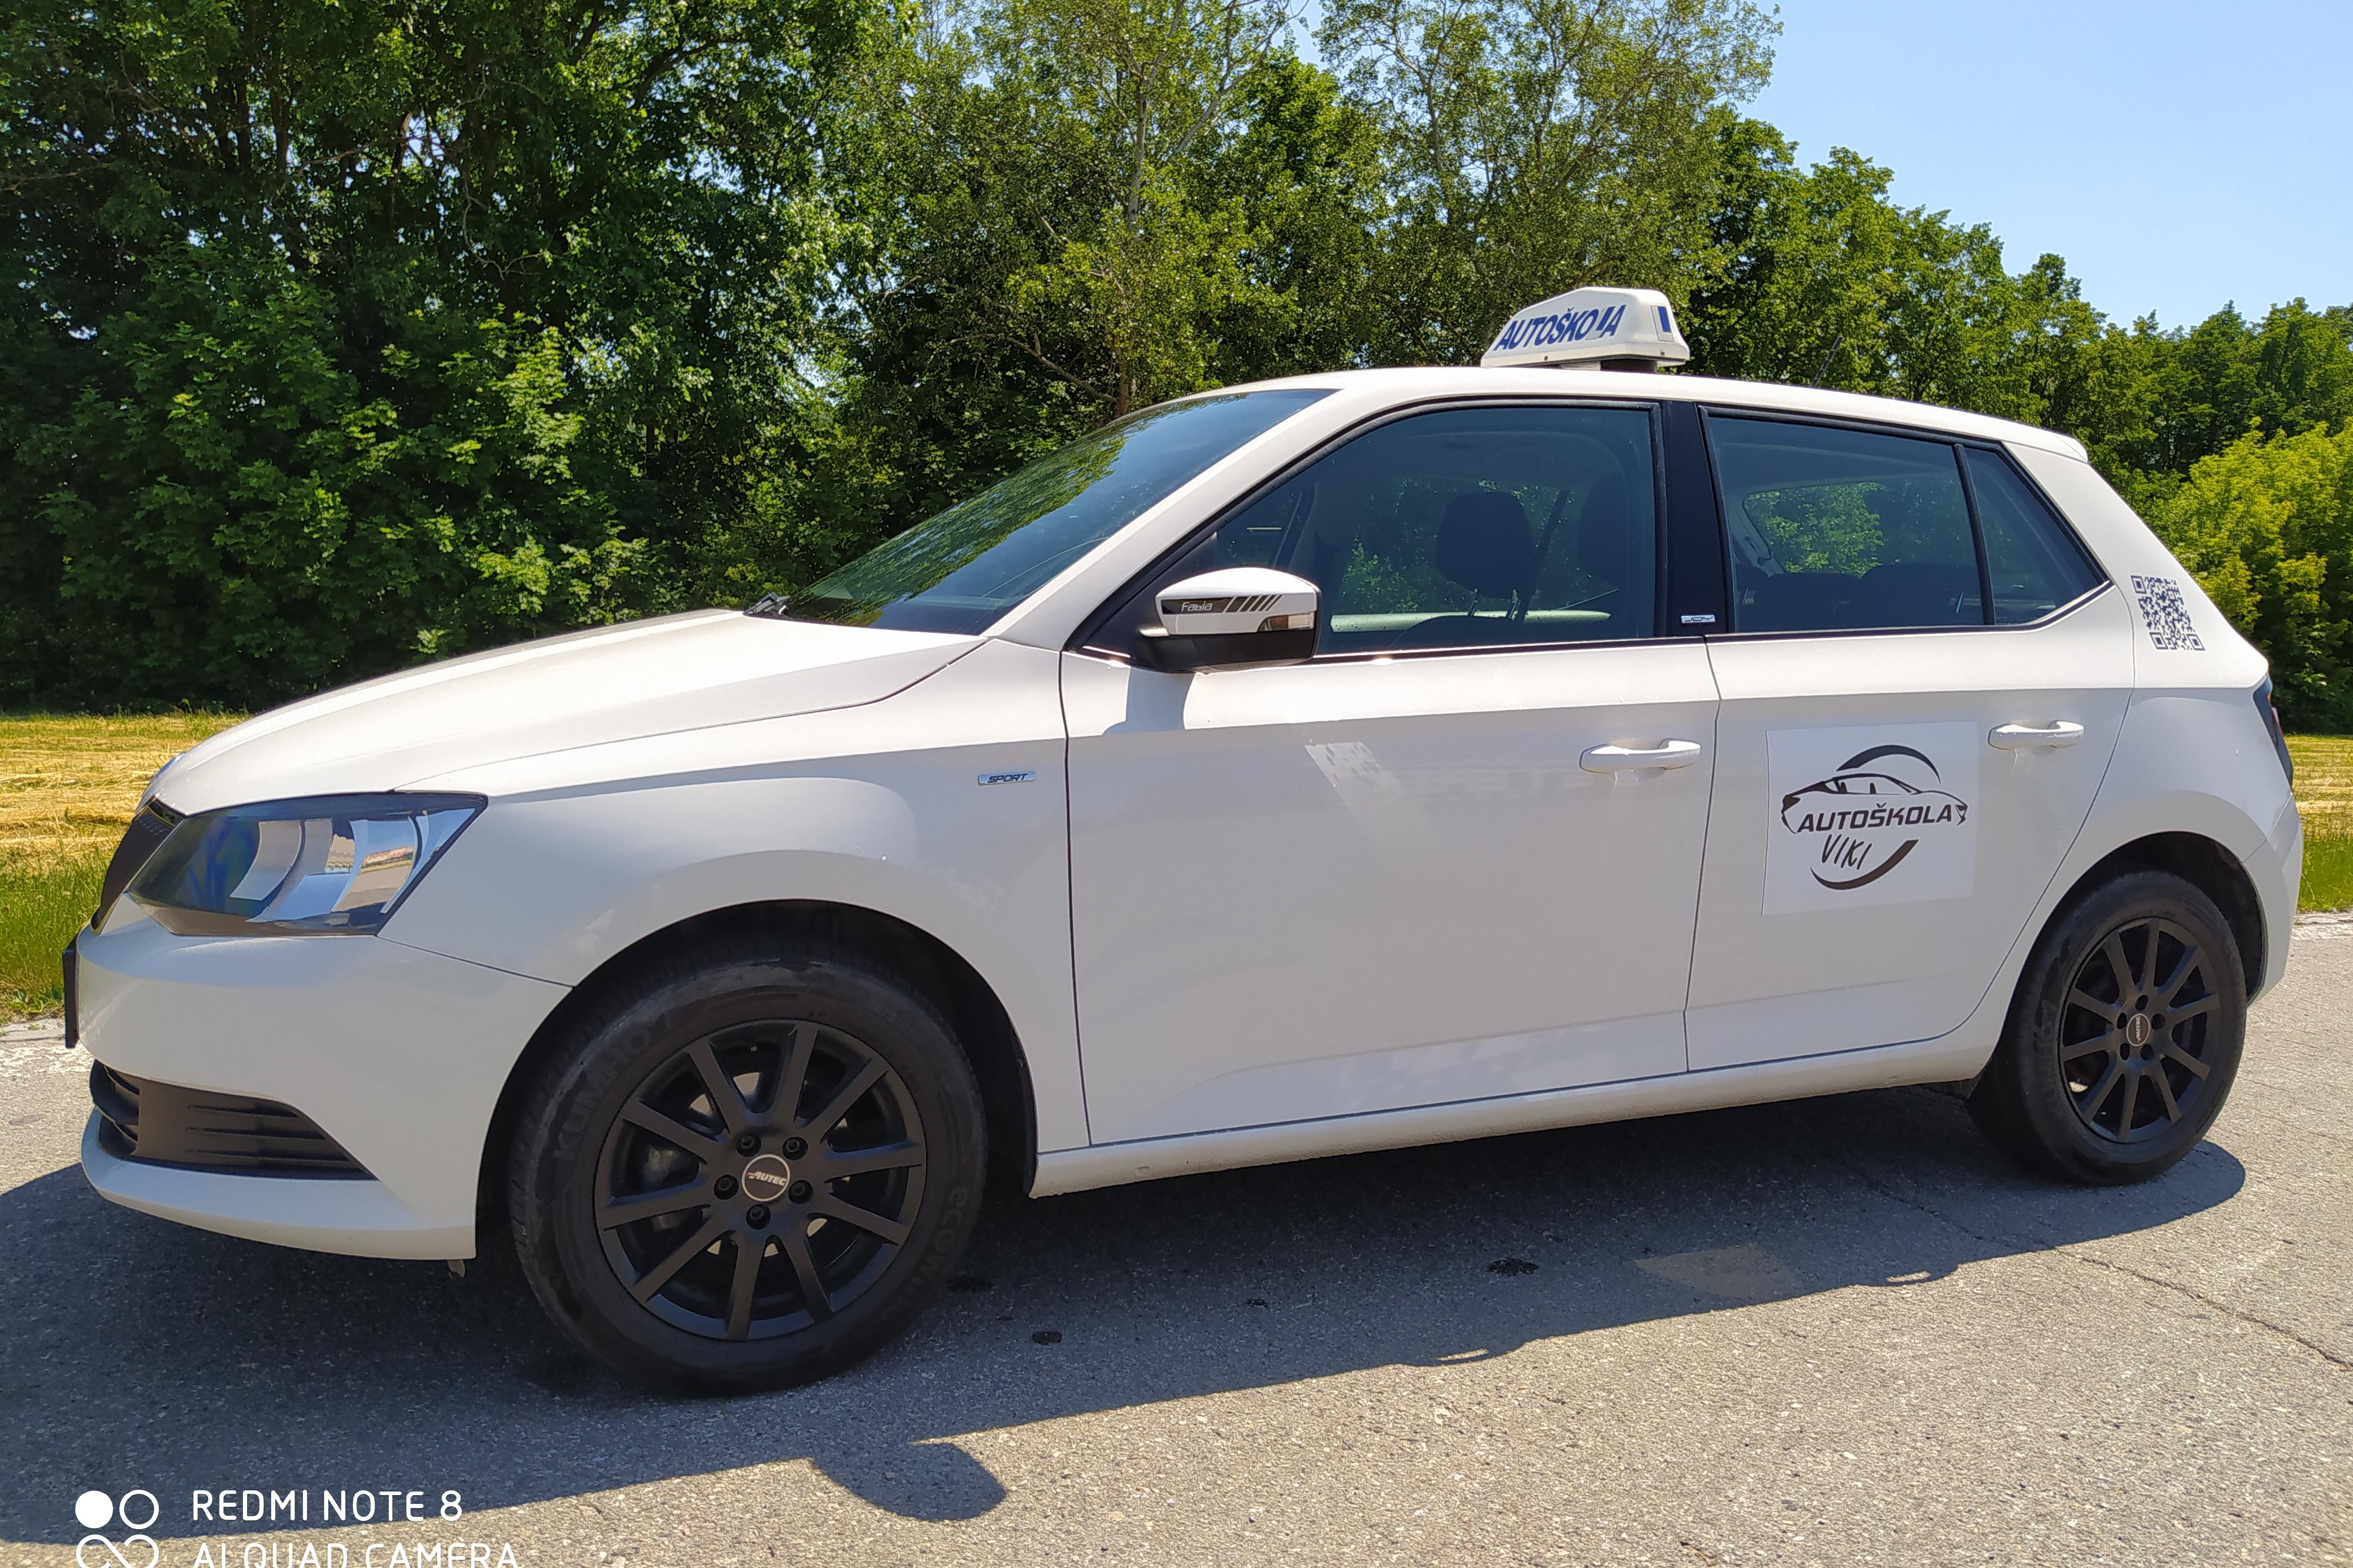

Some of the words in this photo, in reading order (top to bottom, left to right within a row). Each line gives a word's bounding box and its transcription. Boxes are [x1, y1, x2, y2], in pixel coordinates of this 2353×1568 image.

[1181, 601, 1212, 612] Fabia
[988, 773, 1028, 783] SPORT
[1797, 802, 1952, 833] AUTOŠKOLA
[1822, 834, 1872, 870] VIKI
[748, 1171, 787, 1186] AUTEC
